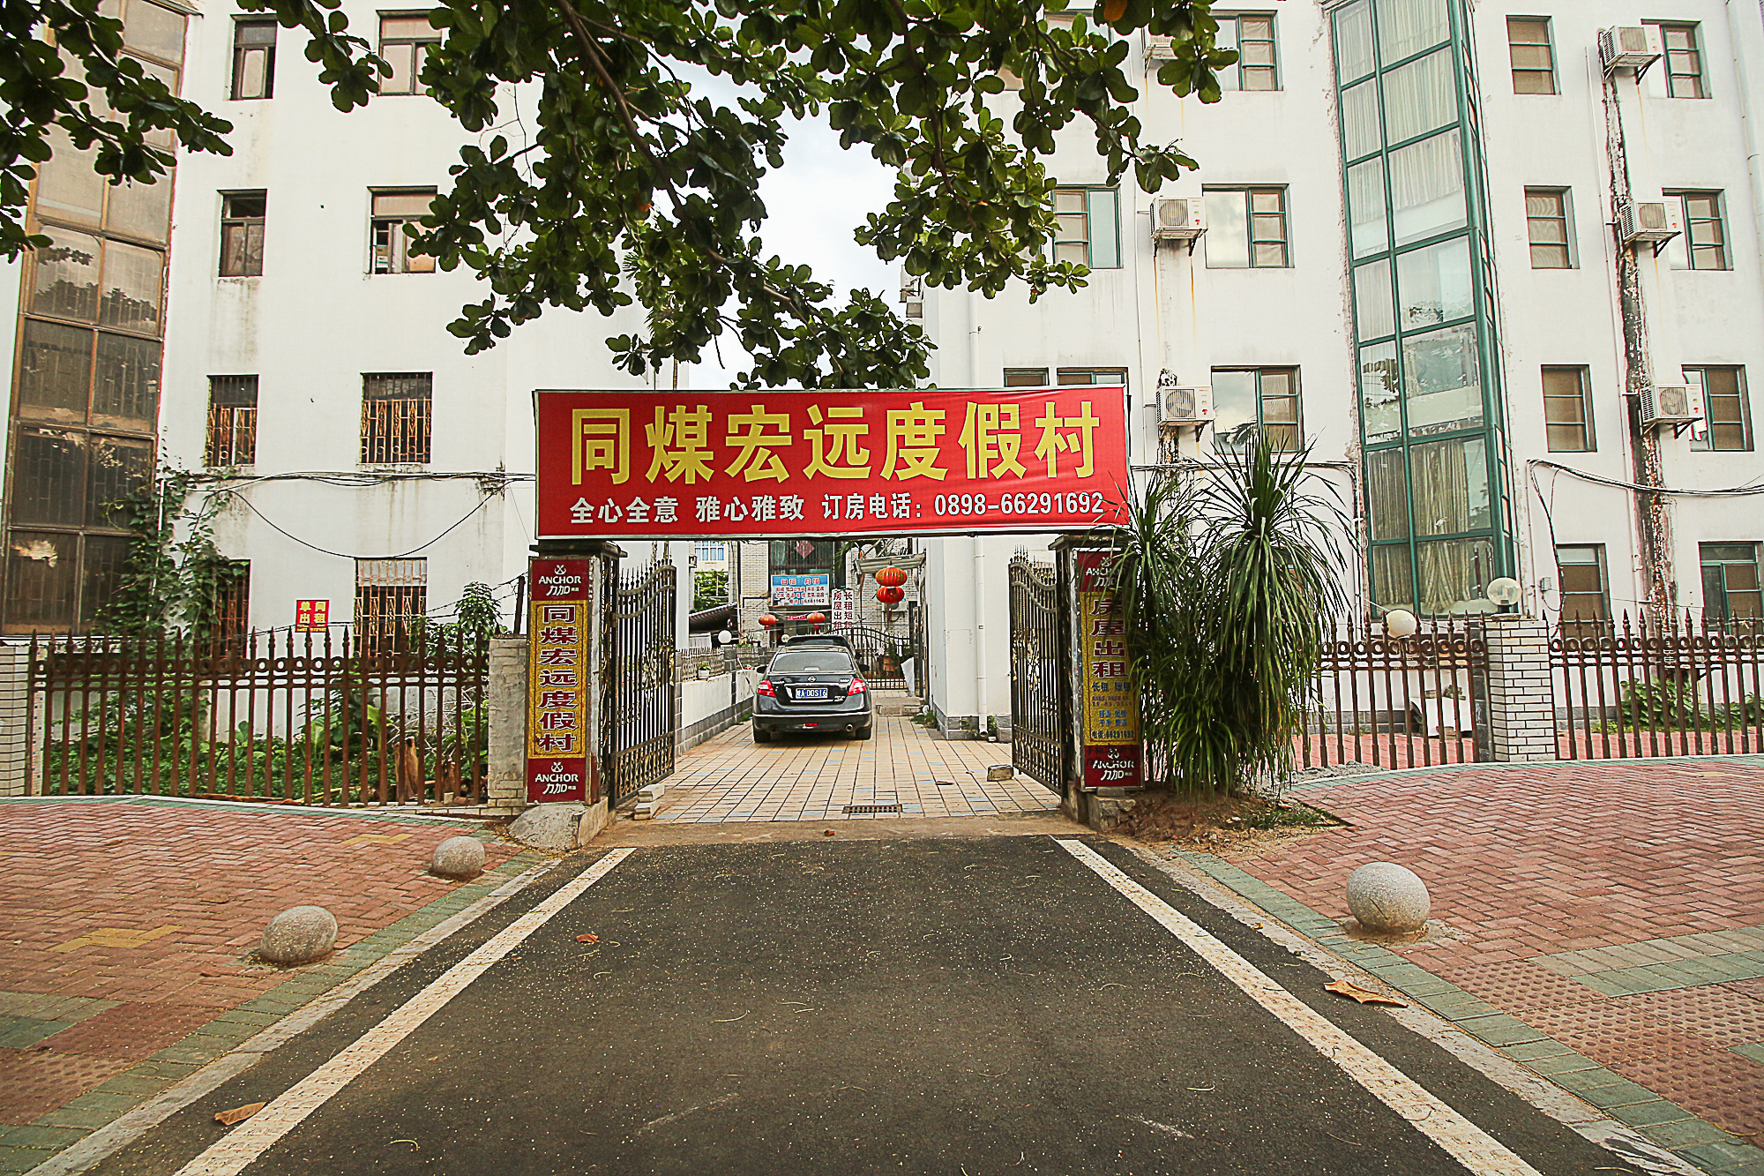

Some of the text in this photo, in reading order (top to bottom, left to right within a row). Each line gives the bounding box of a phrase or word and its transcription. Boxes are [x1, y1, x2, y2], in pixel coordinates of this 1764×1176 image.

[570, 400, 1100, 485] 同煤宏远度假村
[570, 496, 679, 524] 全心全意
[695, 493, 805, 523] 雅心雅致
[538, 575, 582, 584] ANCHOR
[1090, 599, 1129, 678] 房屋出租
[537, 605, 579, 752] 同煤宏远度假村
[534, 773, 579, 783] ANCHOR
[1092, 760, 1135, 769] ANCHOR
